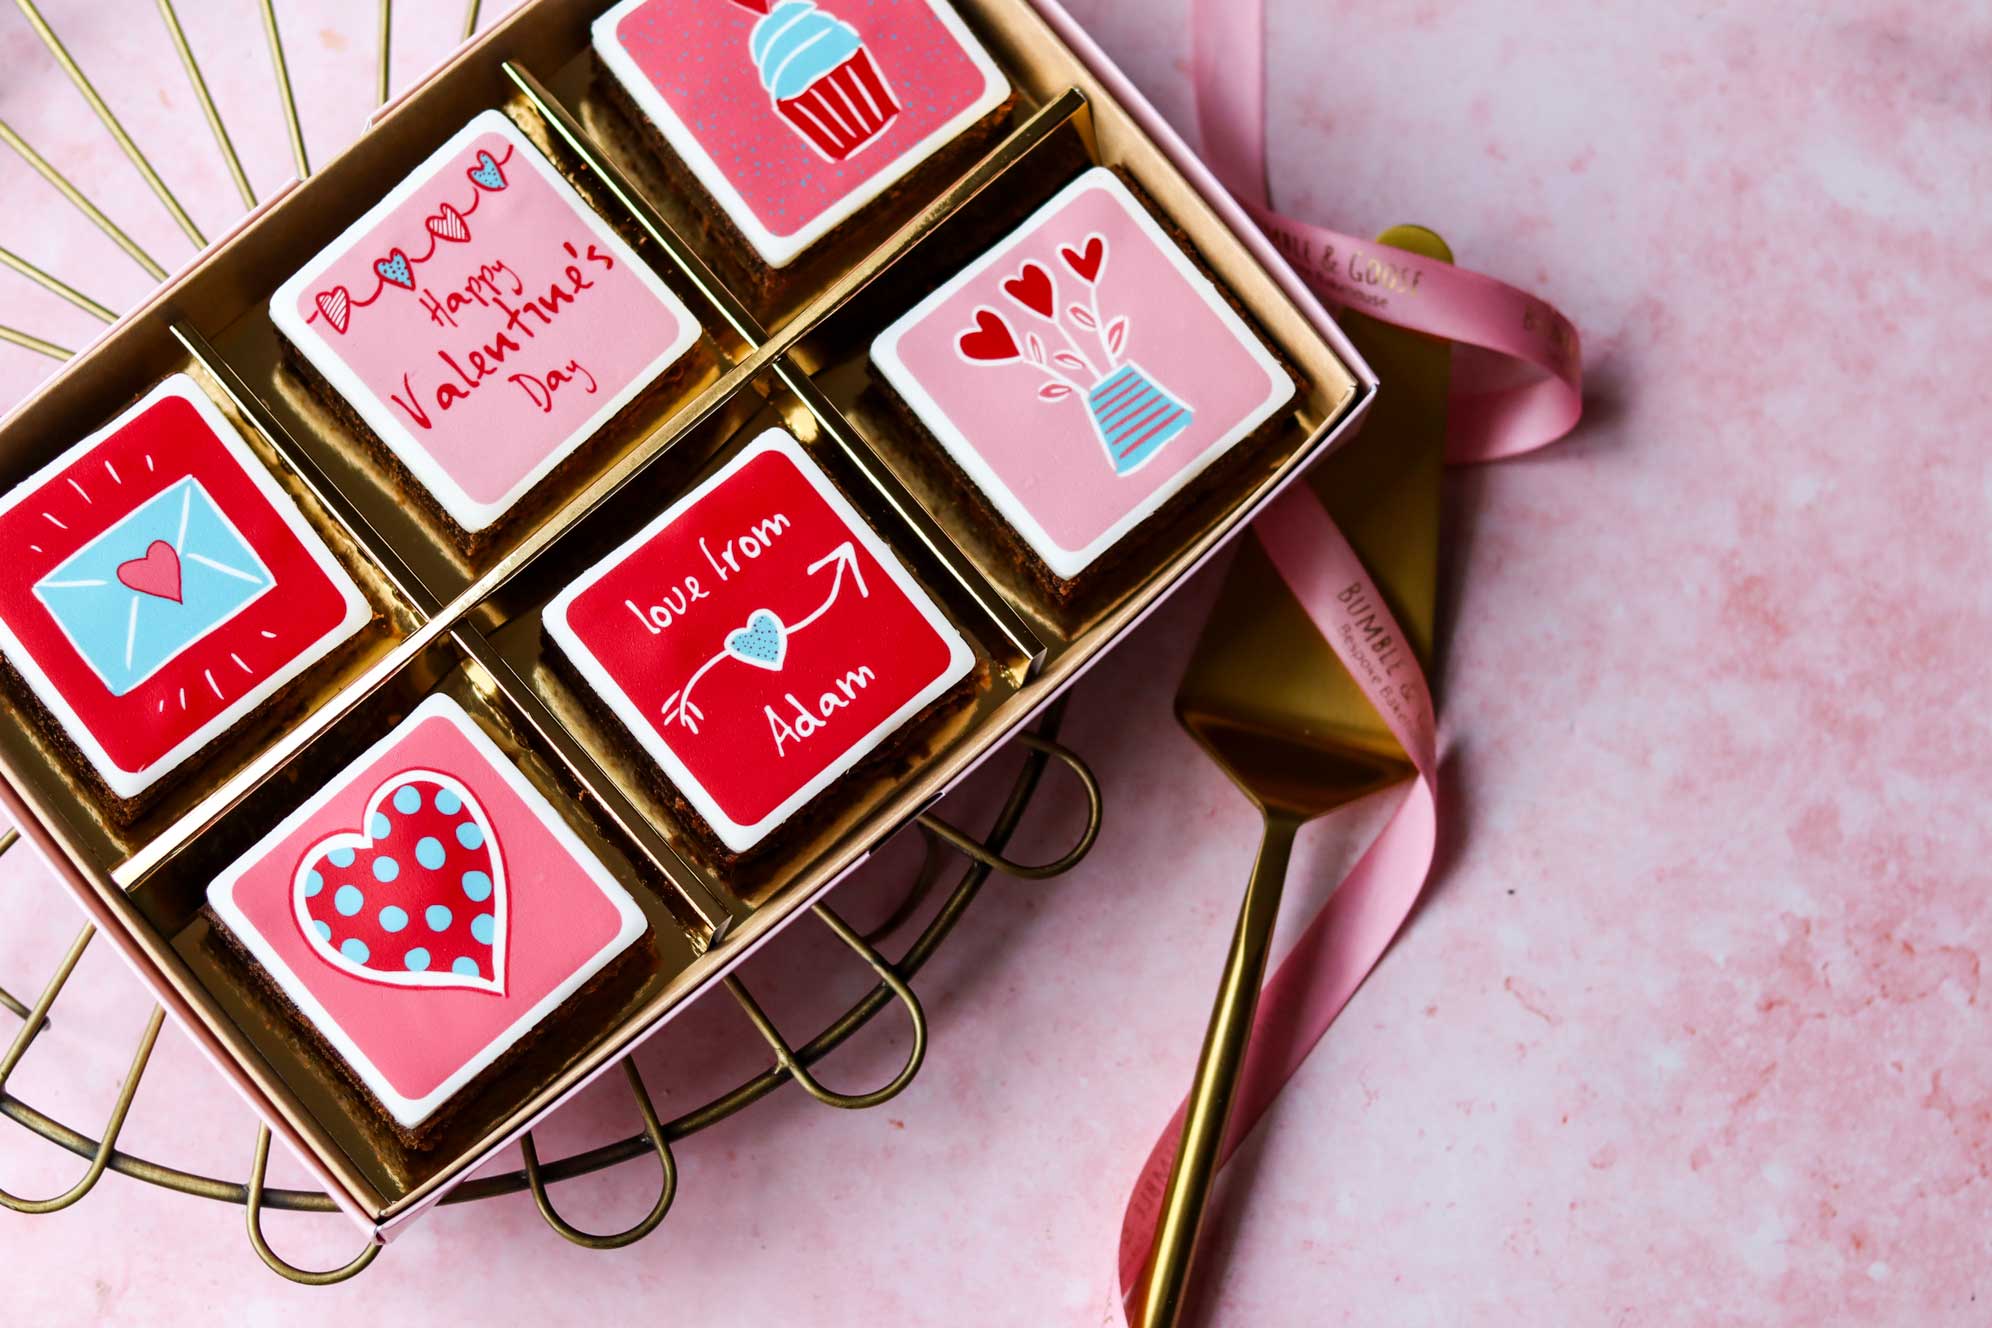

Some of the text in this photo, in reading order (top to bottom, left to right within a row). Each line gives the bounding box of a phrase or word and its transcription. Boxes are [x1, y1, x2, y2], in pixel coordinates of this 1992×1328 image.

[418, 260, 523, 328] Happy
[1320, 245, 1338, 272] &
[1347, 249, 1423, 298] GOOSE
[390, 241, 614, 430] Valentine's
[507, 360, 597, 413] Day
[624, 513, 792, 634] love from
[1336, 581, 1402, 678] BUMBLE
[764, 665, 876, 758] Adam
